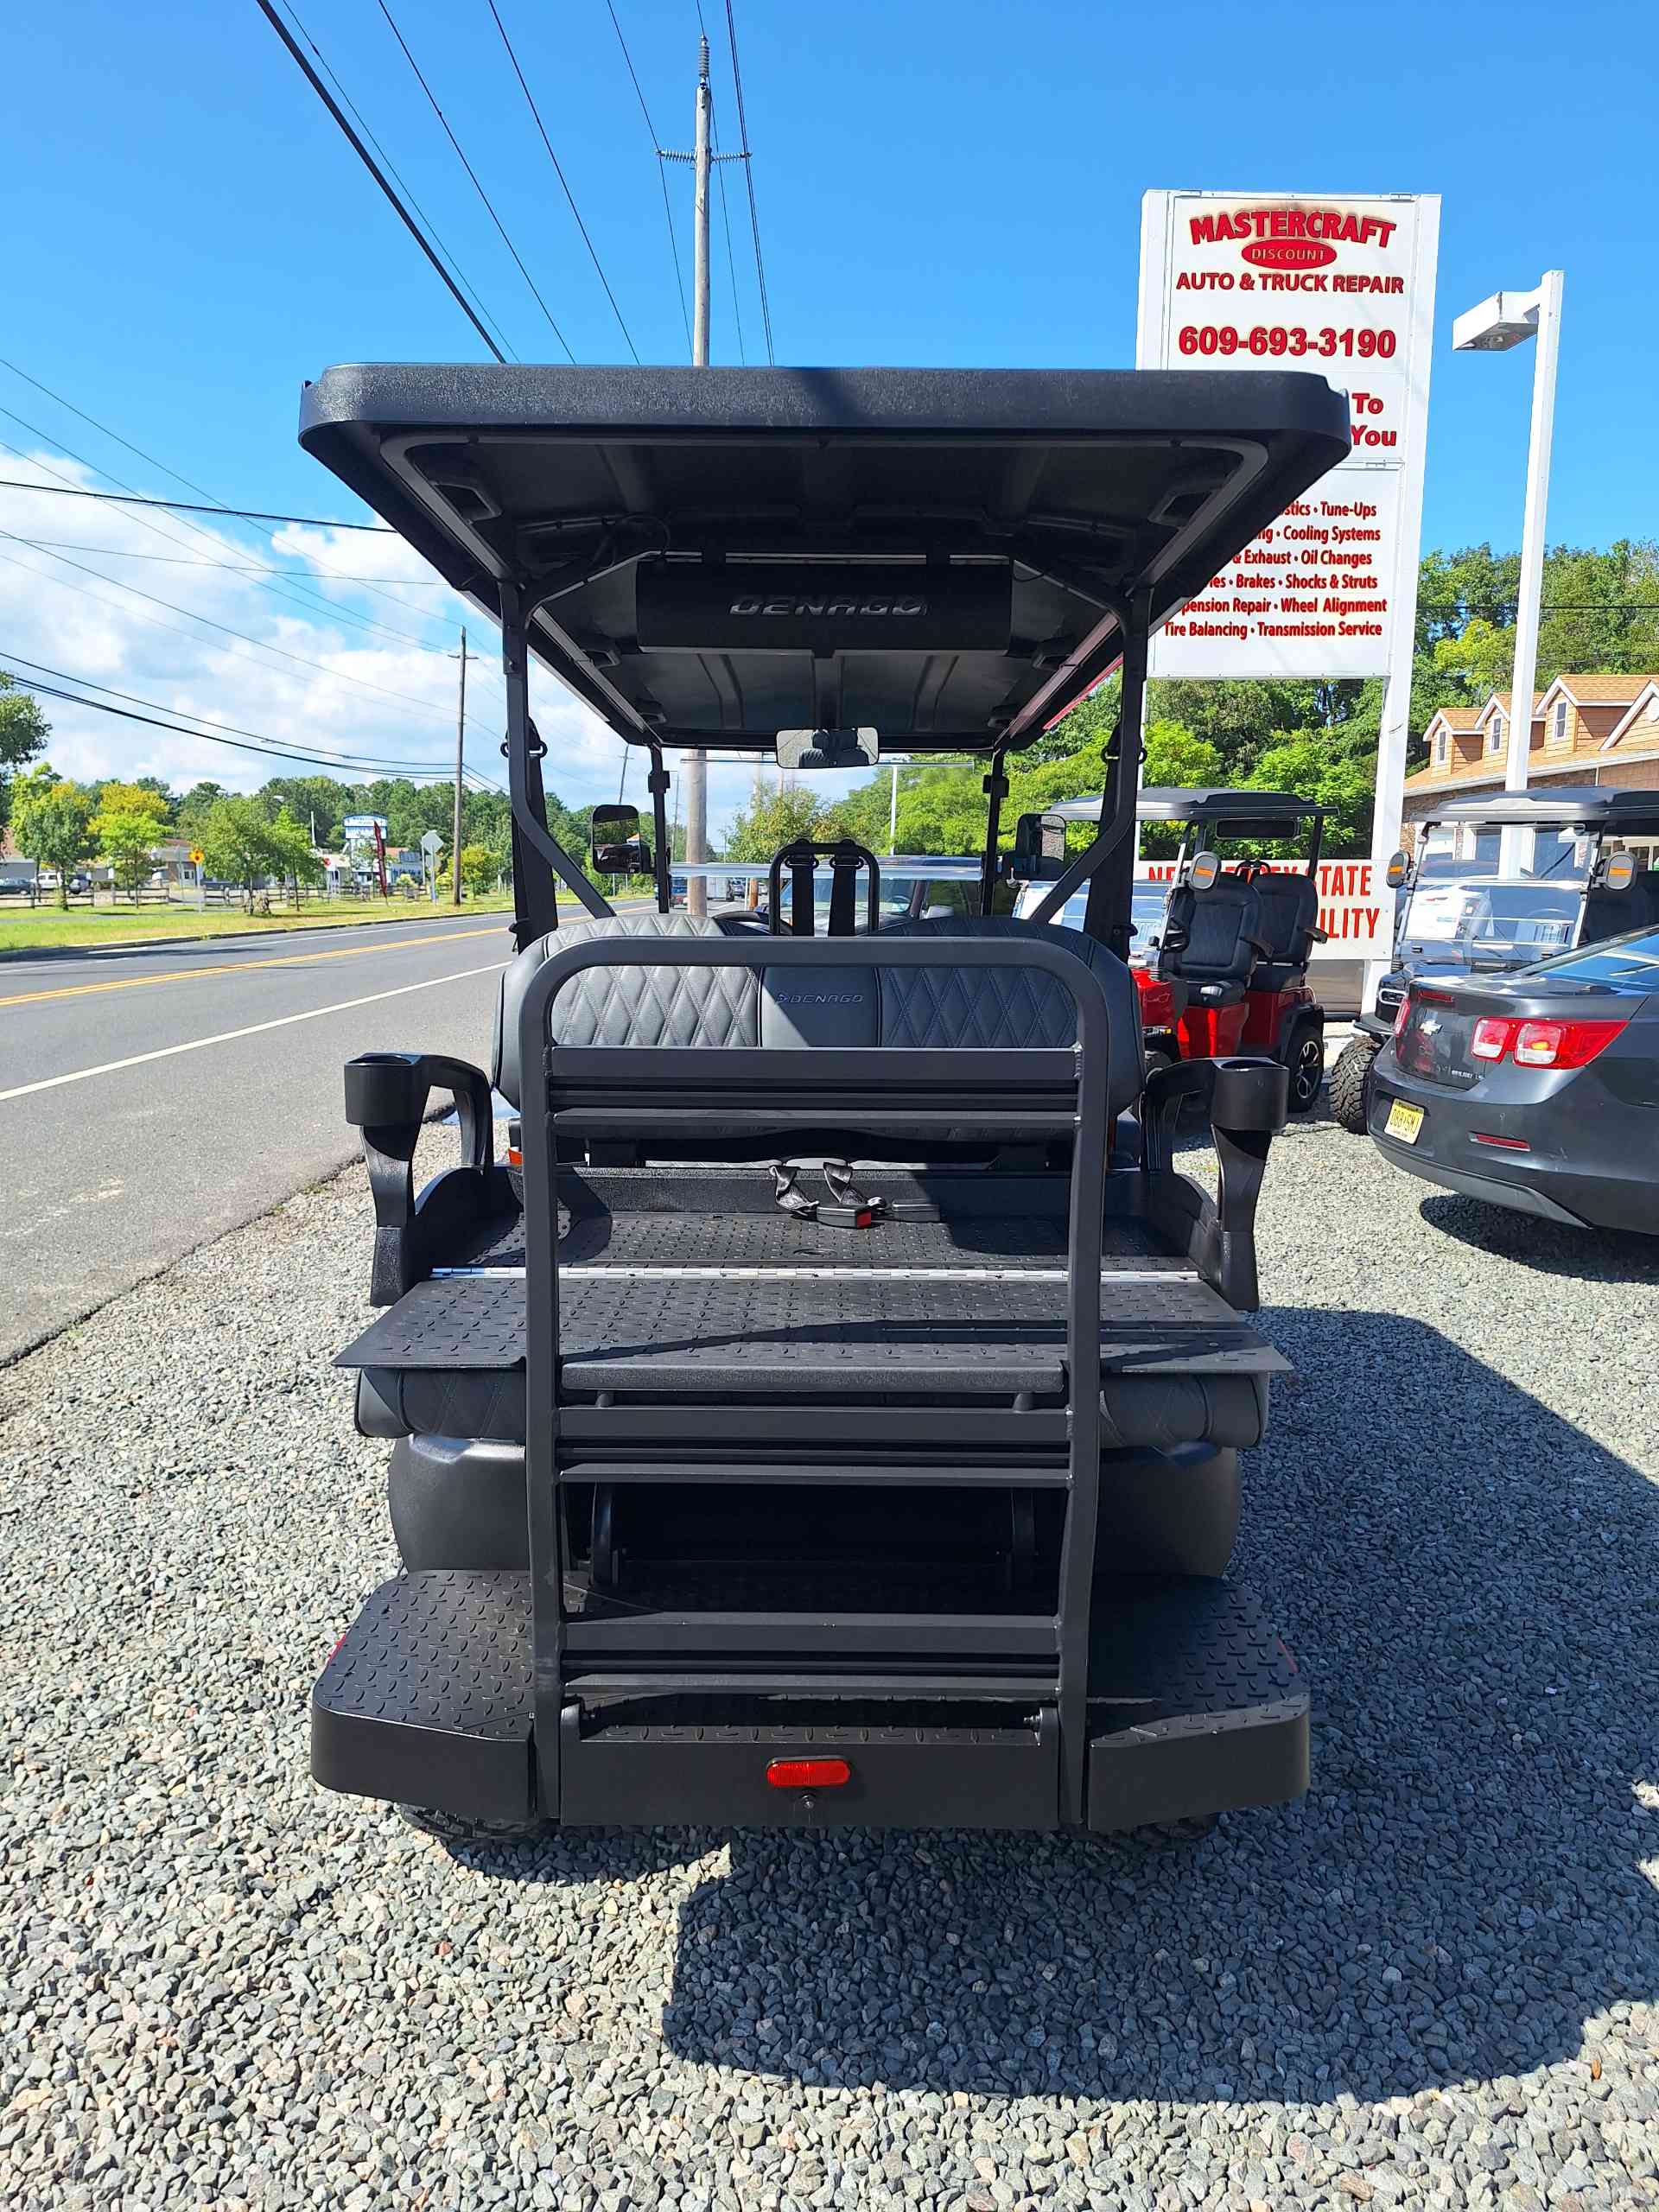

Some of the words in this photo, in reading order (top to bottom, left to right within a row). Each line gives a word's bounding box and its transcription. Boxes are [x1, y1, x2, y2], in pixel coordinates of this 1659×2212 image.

[1189, 209, 1397, 248] MASTERCRAFT
[1251, 247, 1325, 262] DISCOUNT
[1176, 272, 1235, 290] AUTO
[1239, 273, 1255, 290] &
[1259, 273, 1328, 292] TRUCK
[1332, 276, 1404, 294] REPAIR
[1178, 326, 1396, 359] 609-693-3190
[1351, 393, 1384, 414] To
[1351, 425, 1397, 447] You
[1281, 500, 1311, 516] stics
[1319, 500, 1377, 520] Tune-Ups
[1283, 524, 1329, 545] Cooling
[1332, 525, 1381, 544] Systems
[1244, 549, 1292, 564] Exhaust
[1301, 549, 1319, 565] Oil
[1320, 549, 1373, 569] Changes
[1236, 573, 1276, 588] Brakes
[1285, 573, 1328, 588] Shocks
[1329, 574, 1339, 588] &
[1342, 573, 1378, 588] Struts
[729, 594, 928, 616] DENAGO
[1180, 597, 1230, 616] pension
[1232, 598, 1272, 616] Repair
[1281, 597, 1319, 613] Wheel
[1323, 597, 1388, 616] Alignment
[1164, 620, 1187, 637] Tire
[1189, 620, 1249, 640] Balancing
[1257, 620, 1336, 637] Transmission
[1338, 620, 1382, 636] Service
[1309, 866, 1373, 896] TATE
[1319, 908, 1381, 938] ILITY
[789, 995, 865, 1003] DENAGO
